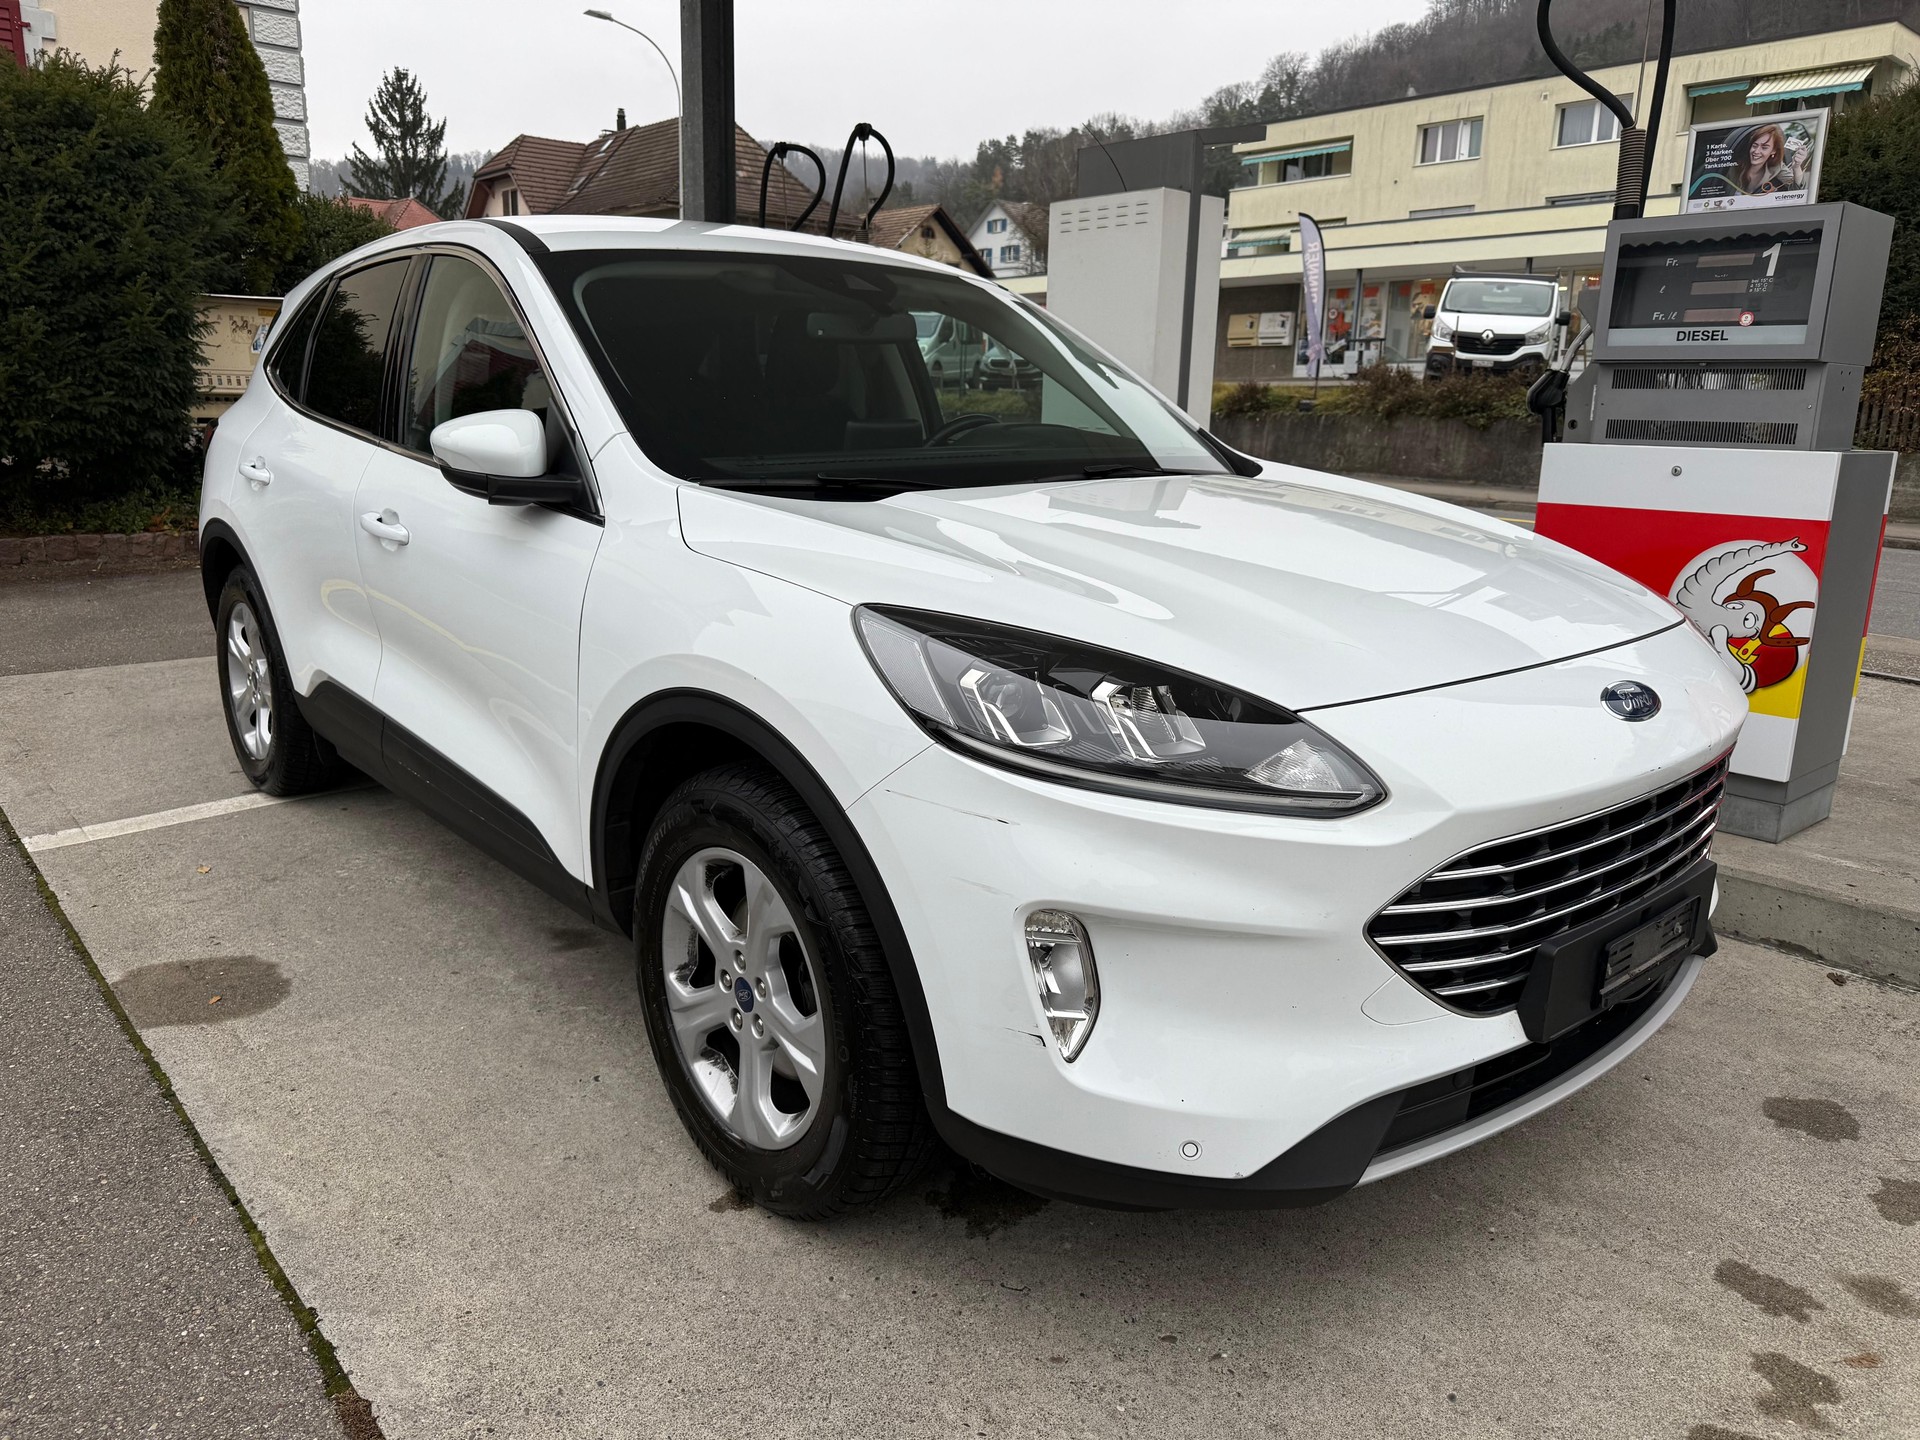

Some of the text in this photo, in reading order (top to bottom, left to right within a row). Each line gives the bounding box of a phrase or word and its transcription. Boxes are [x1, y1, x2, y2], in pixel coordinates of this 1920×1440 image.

[1705, 161, 1739, 169] Tankstellen.
[1666, 258, 1679, 267] Fr.
[1762, 243, 1782, 277] 1
[1652, 311, 1665, 320] Fr.
[1675, 330, 1729, 341] DIESEL
[1617, 687, 1653, 712] Ford
